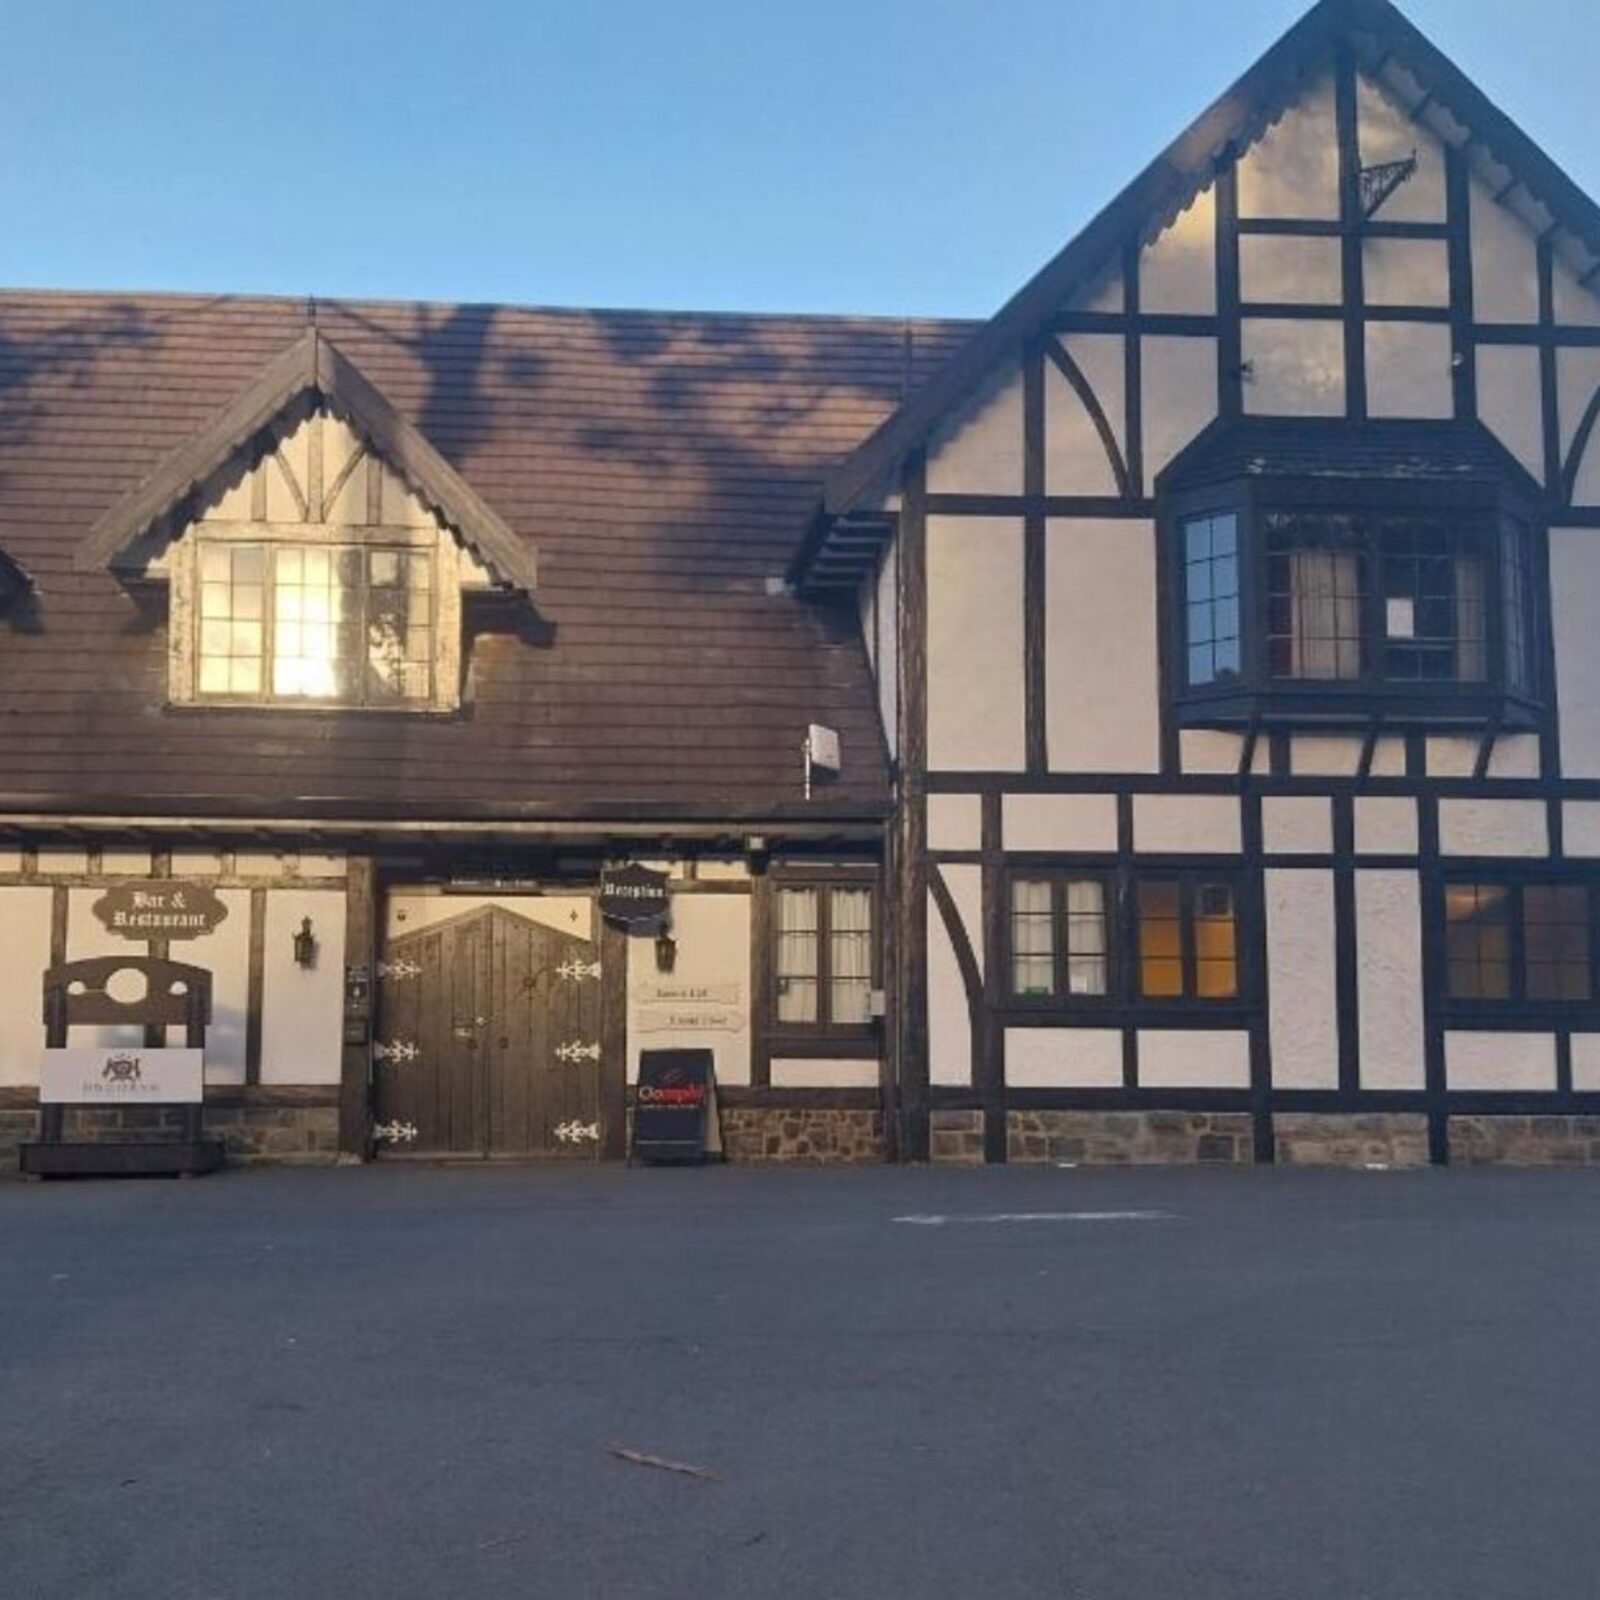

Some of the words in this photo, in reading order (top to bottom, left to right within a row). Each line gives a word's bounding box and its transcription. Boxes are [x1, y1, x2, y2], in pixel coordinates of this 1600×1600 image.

[132, 890, 164, 909] Bar
[171, 891, 185, 909] &
[113, 910, 206, 927] Restaurant
